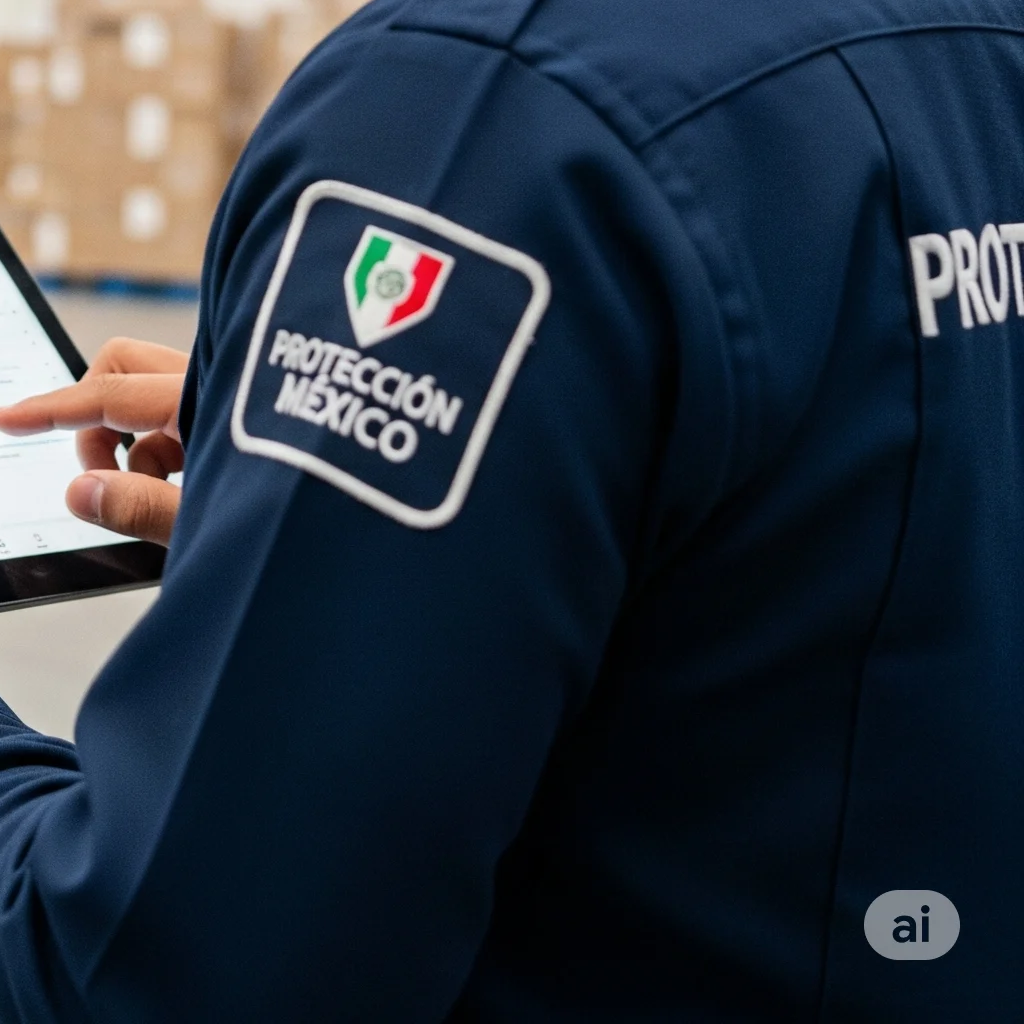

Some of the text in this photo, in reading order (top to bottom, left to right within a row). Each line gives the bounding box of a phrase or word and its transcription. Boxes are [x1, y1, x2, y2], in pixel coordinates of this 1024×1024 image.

[909, 223, 1024, 337] PROT
[268, 329, 463, 435] PROTECCIÓN
[274, 371, 418, 463] MÉXICO
